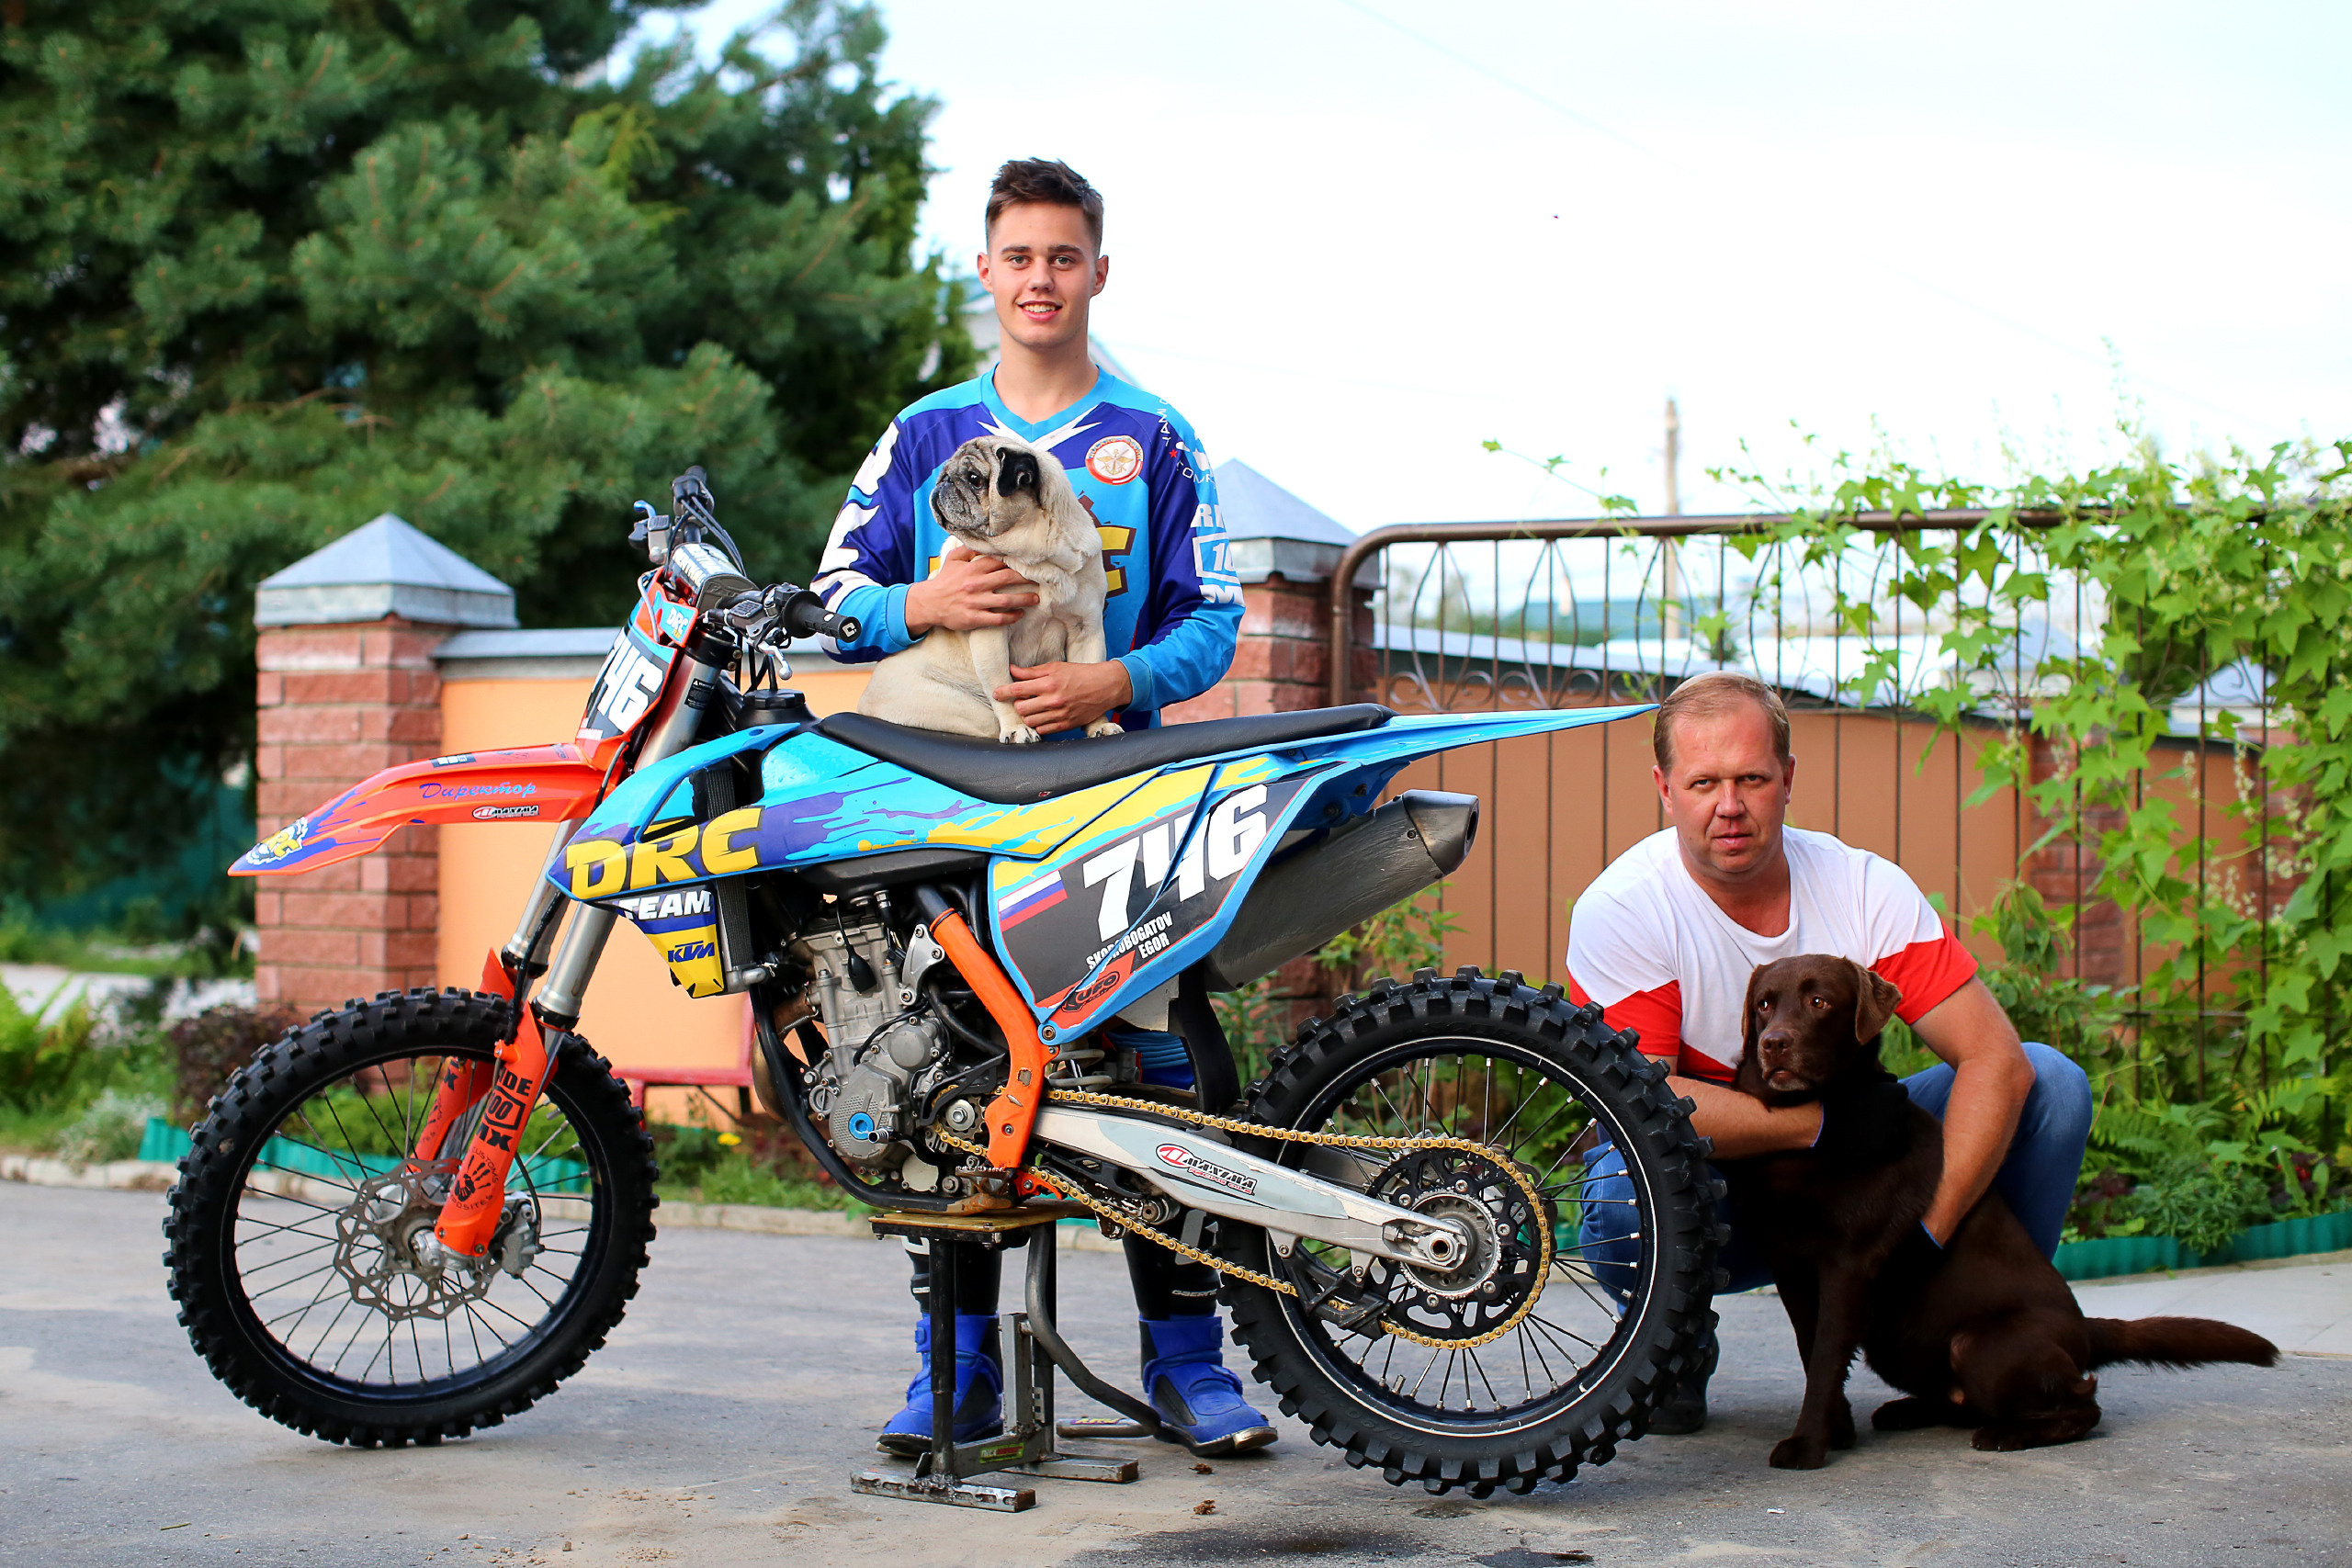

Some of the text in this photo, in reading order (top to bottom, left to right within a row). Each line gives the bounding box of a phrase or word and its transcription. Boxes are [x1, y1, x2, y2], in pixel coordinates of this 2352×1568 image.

[666, 607, 689, 634] DRC
[419, 782, 537, 801] Директор
[565, 807, 763, 900] DRC
[1082, 784, 1268, 942] 746
[618, 890, 712, 920] TEAM
[667, 941, 716, 964] KTM
[1137, 931, 1170, 960] EGOR
[1076, 973, 1118, 1003] UFO
[499, 1066, 533, 1097] IDE
[488, 1091, 514, 1121] 00
[471, 1146, 499, 1184] CUSTOMS
[1182, 1156, 1257, 1190] MAXIMA
